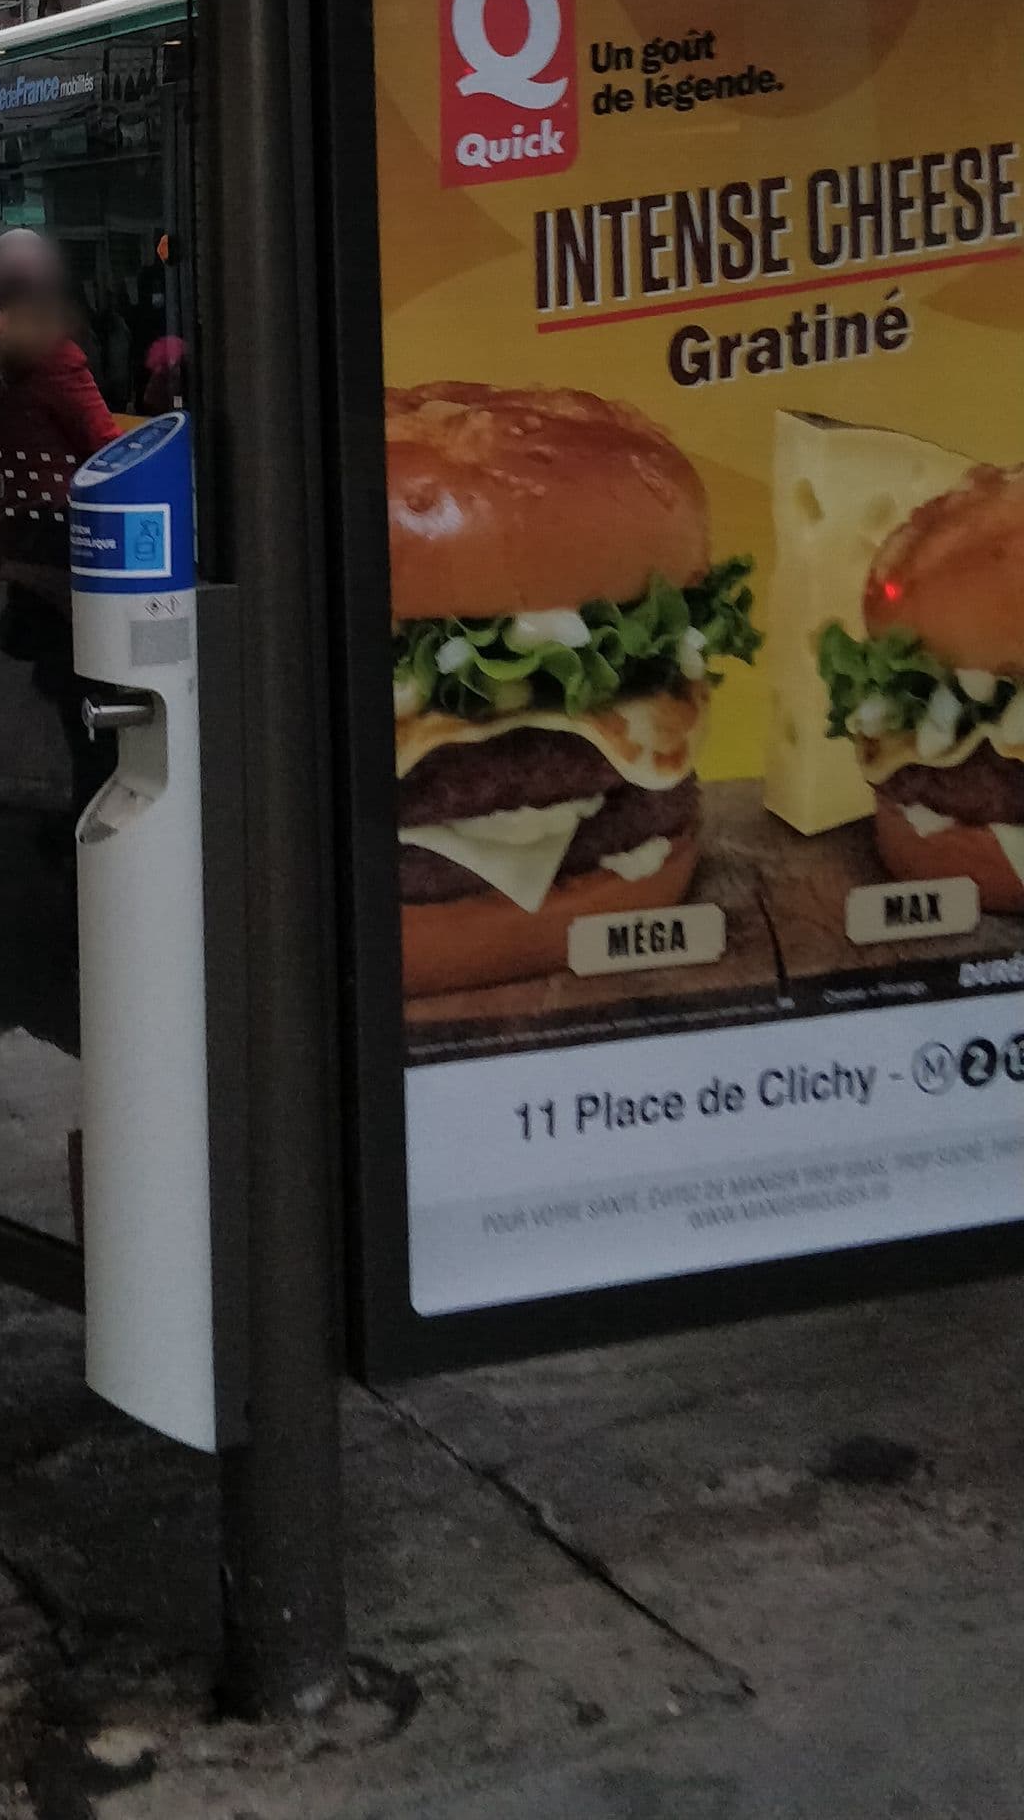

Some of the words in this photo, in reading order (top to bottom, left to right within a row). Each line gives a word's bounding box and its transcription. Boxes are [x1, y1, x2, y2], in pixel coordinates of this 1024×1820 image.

[590, 41, 633, 74] Un
[641, 28, 716, 74] goût
[60, 72, 94, 97] mobilités
[593, 83, 635, 116] de
[644, 64, 785, 112] légende.
[455, 118, 565, 168] Quick
[534, 176, 795, 312] INTENSE
[808, 142, 1022, 270] CHEESE
[668, 286, 913, 388] Gratiné
[884, 892, 943, 926] MAX
[607, 918, 687, 960] MÉGA
[514, 1098, 557, 1142] 11
[576, 1089, 686, 1136] Place
[697, 1076, 746, 1118] de
[759, 1060, 875, 1108] Clichy
